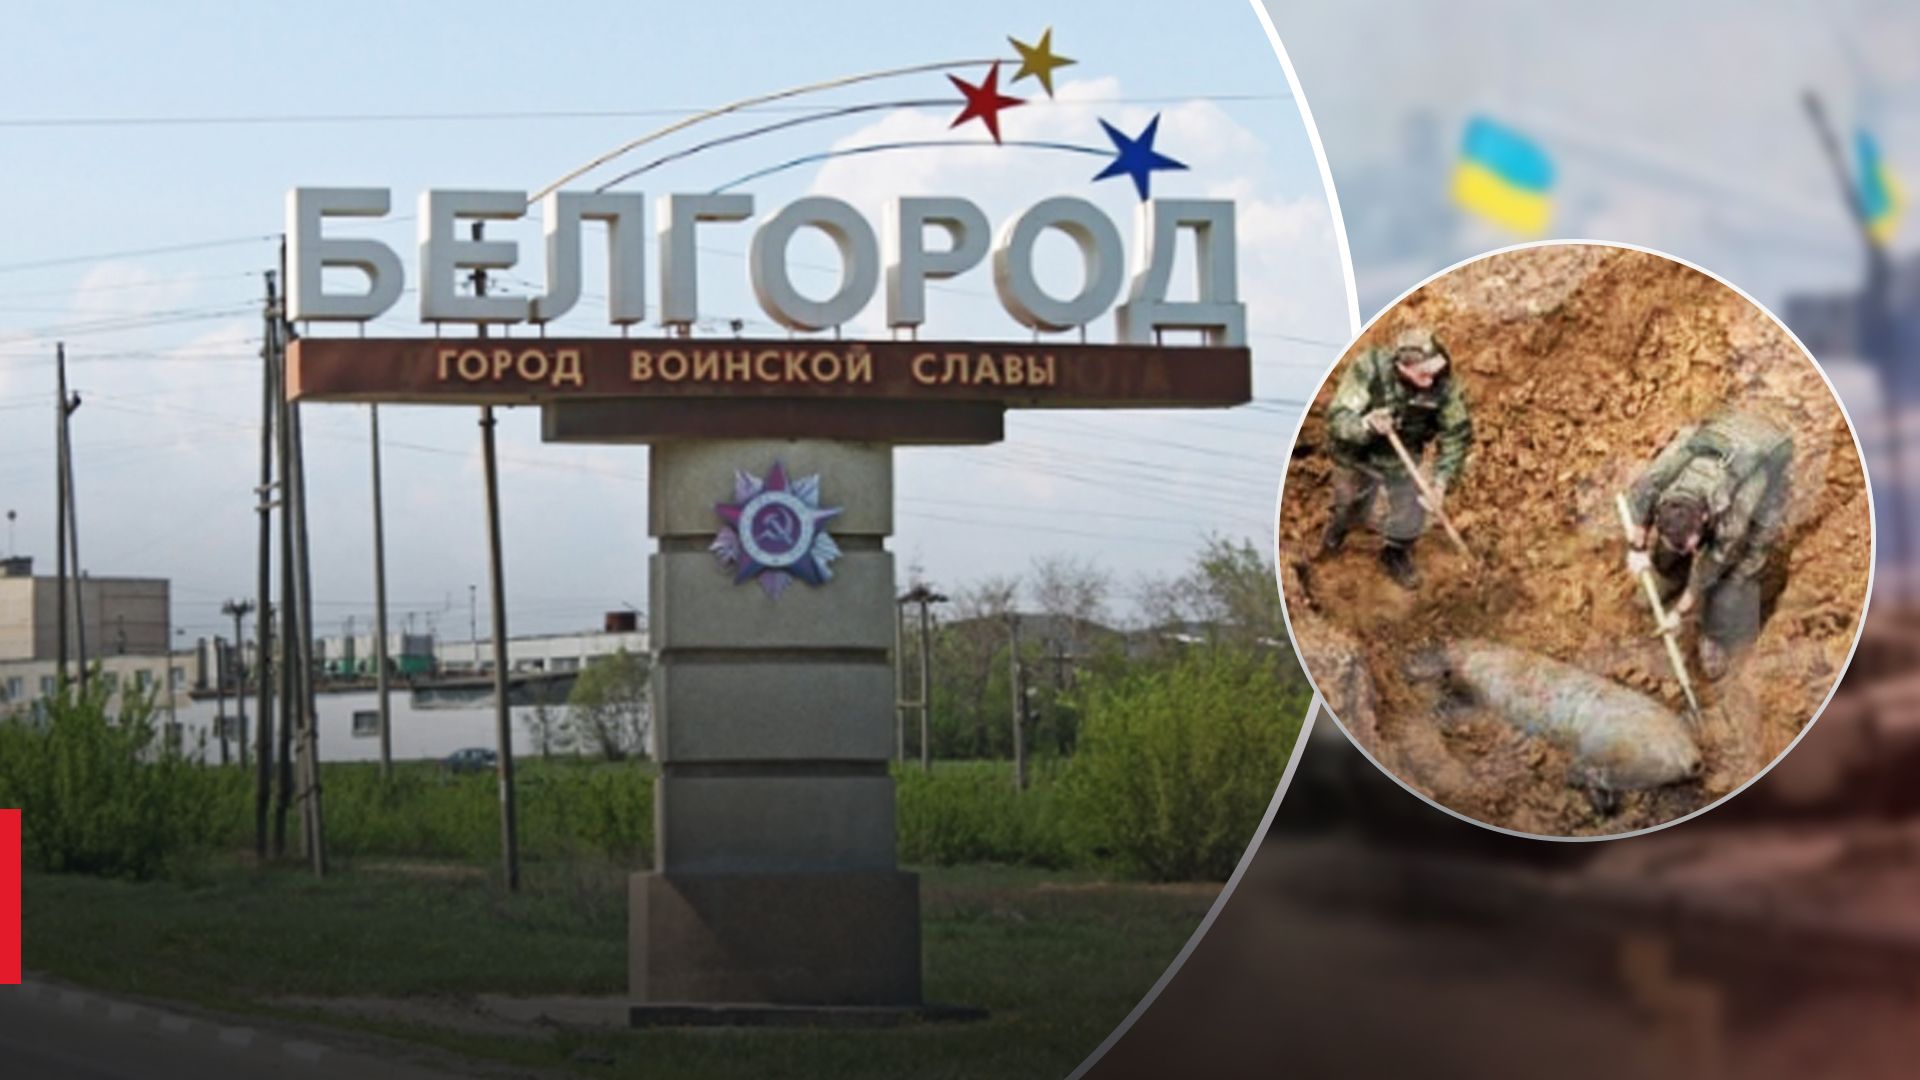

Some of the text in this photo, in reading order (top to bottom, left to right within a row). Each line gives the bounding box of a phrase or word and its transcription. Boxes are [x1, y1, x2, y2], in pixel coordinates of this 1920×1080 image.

[286, 187, 1247, 346] БЕЛГОРОД
[437, 344, 1056, 386] ГОРОД ВОИНСКОЙ СЛАВЫ
